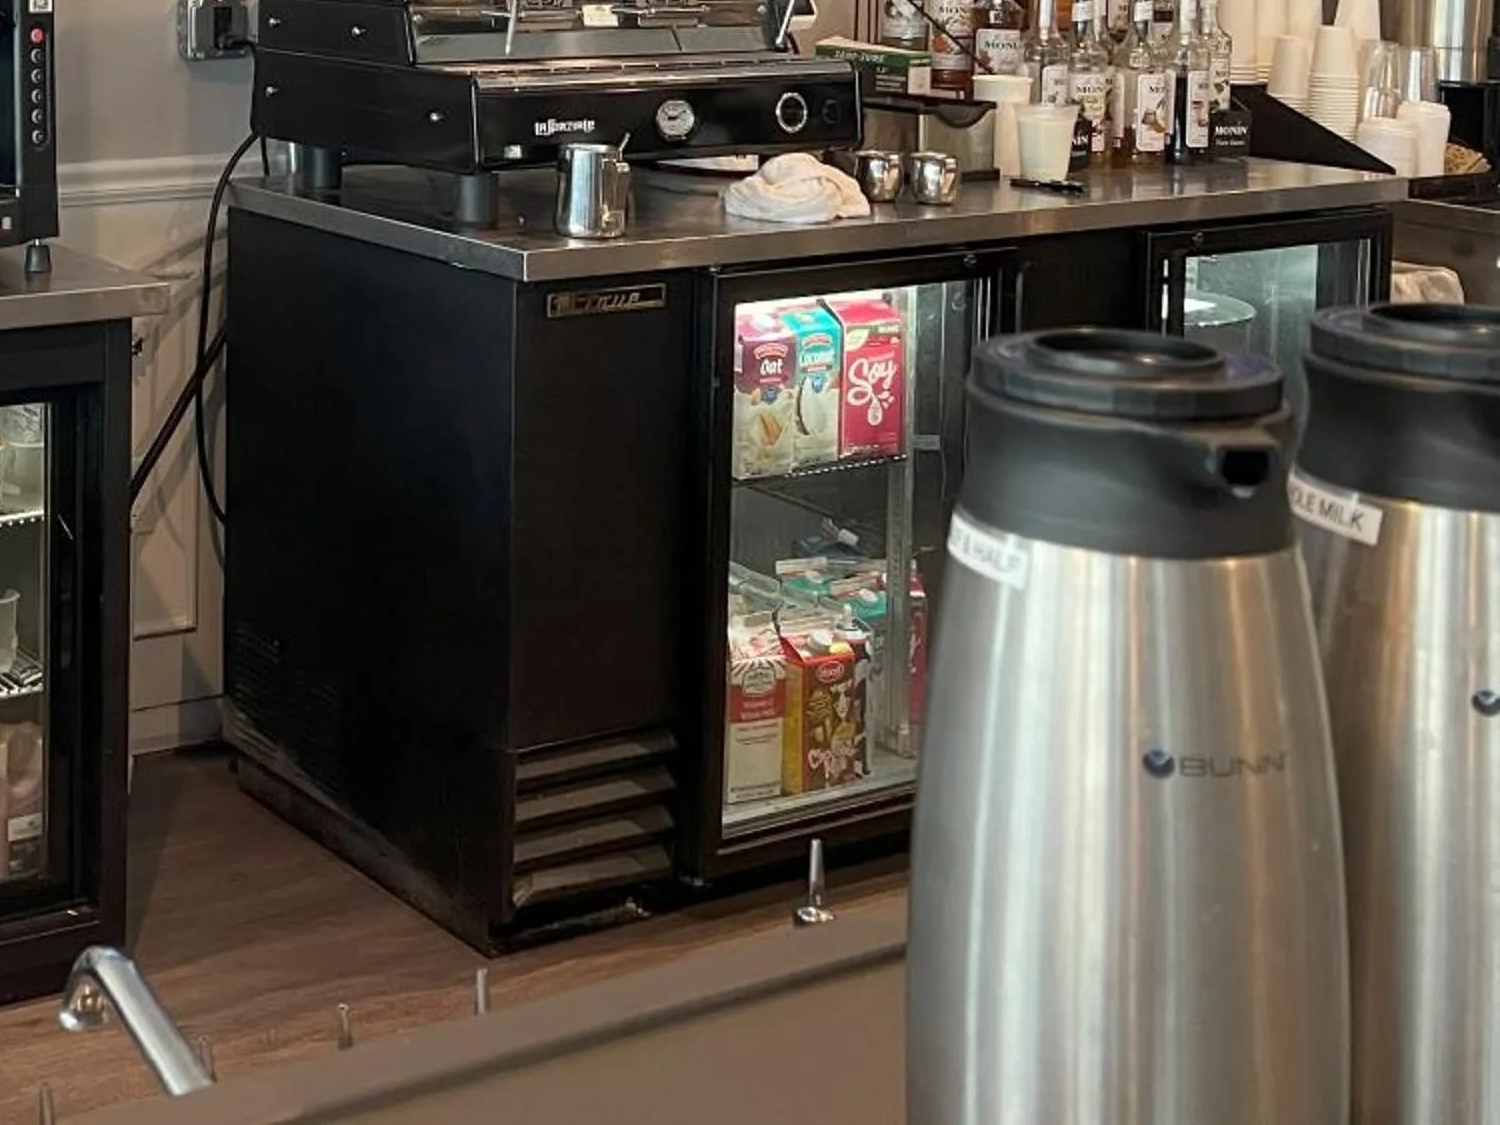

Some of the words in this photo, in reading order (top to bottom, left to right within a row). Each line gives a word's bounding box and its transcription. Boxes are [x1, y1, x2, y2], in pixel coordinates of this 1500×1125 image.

[1213, 124, 1250, 137] MONIN
[847, 358, 898, 405] Soy
[1318, 494, 1365, 532] MILK
[1179, 751, 1286, 778] BUNN
